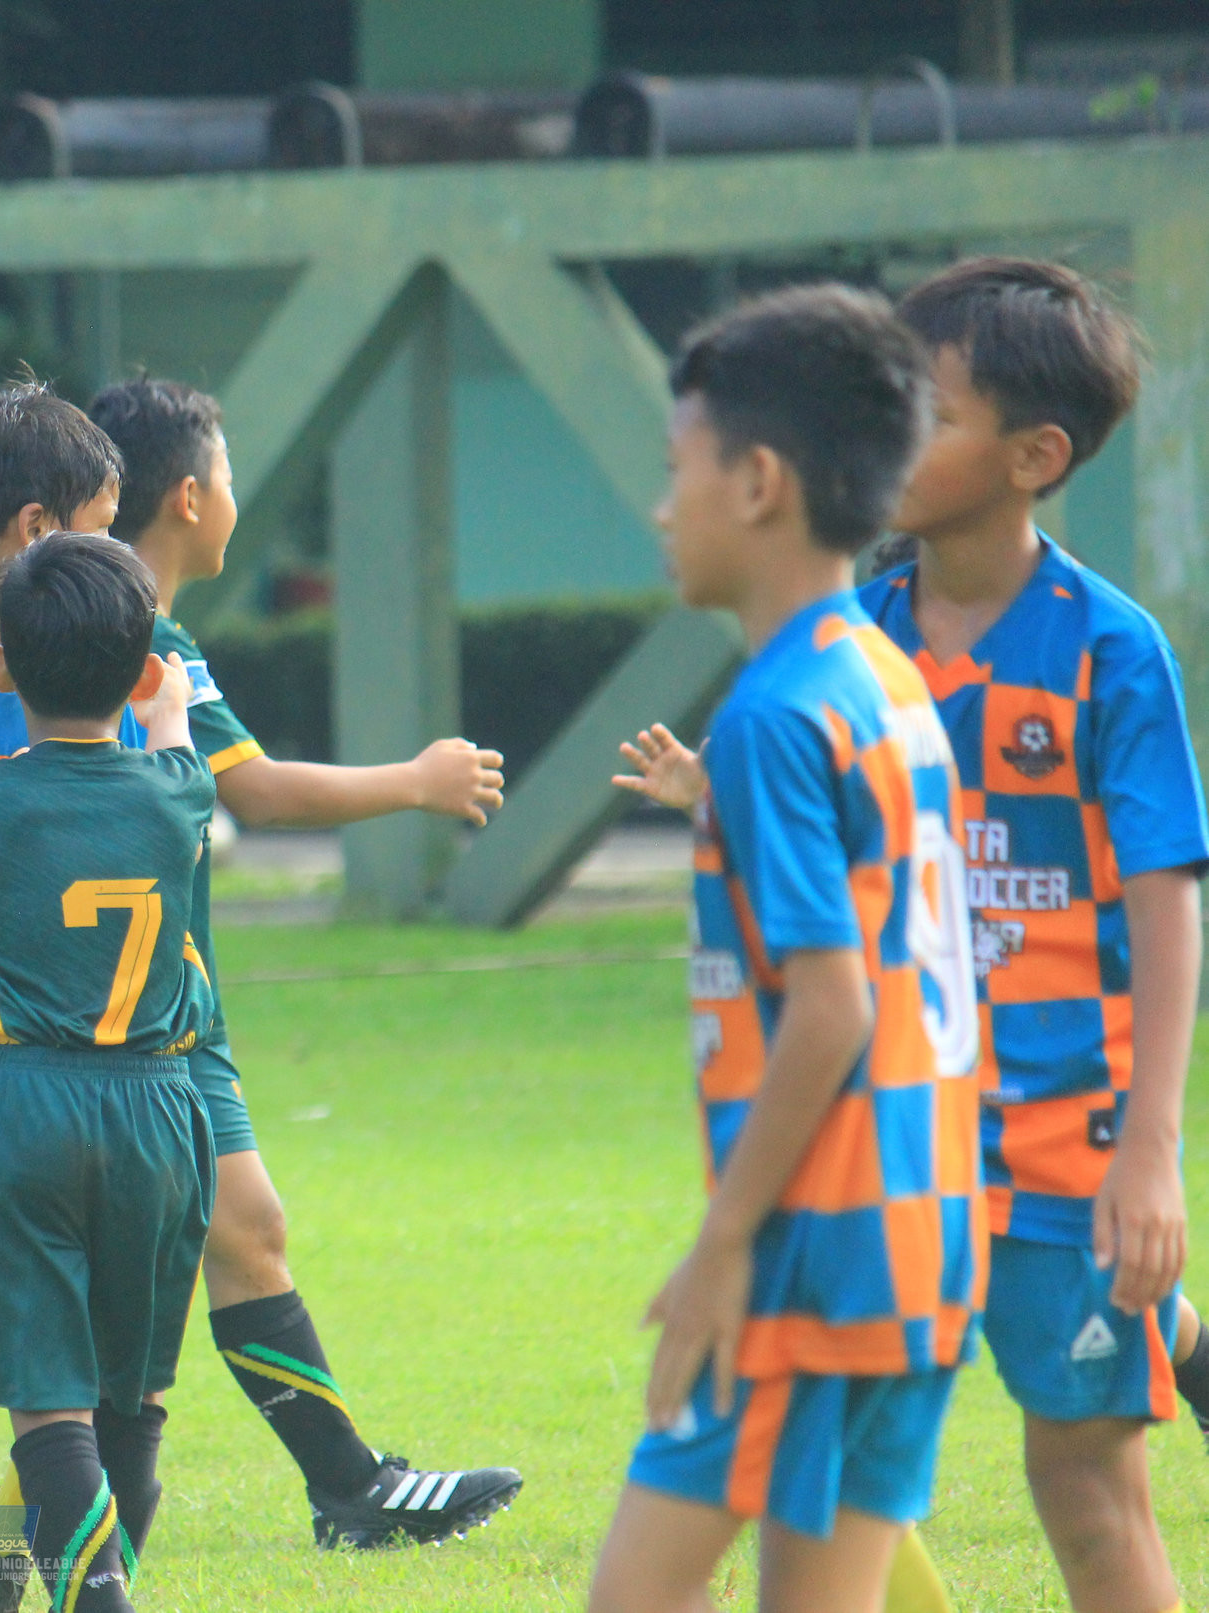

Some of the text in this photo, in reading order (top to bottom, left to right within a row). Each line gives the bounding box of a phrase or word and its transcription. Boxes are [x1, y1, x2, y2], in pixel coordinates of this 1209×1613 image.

[61, 878, 163, 1046] 7
[905, 810, 980, 1078] 9
[967, 868, 1071, 910] OCCER
